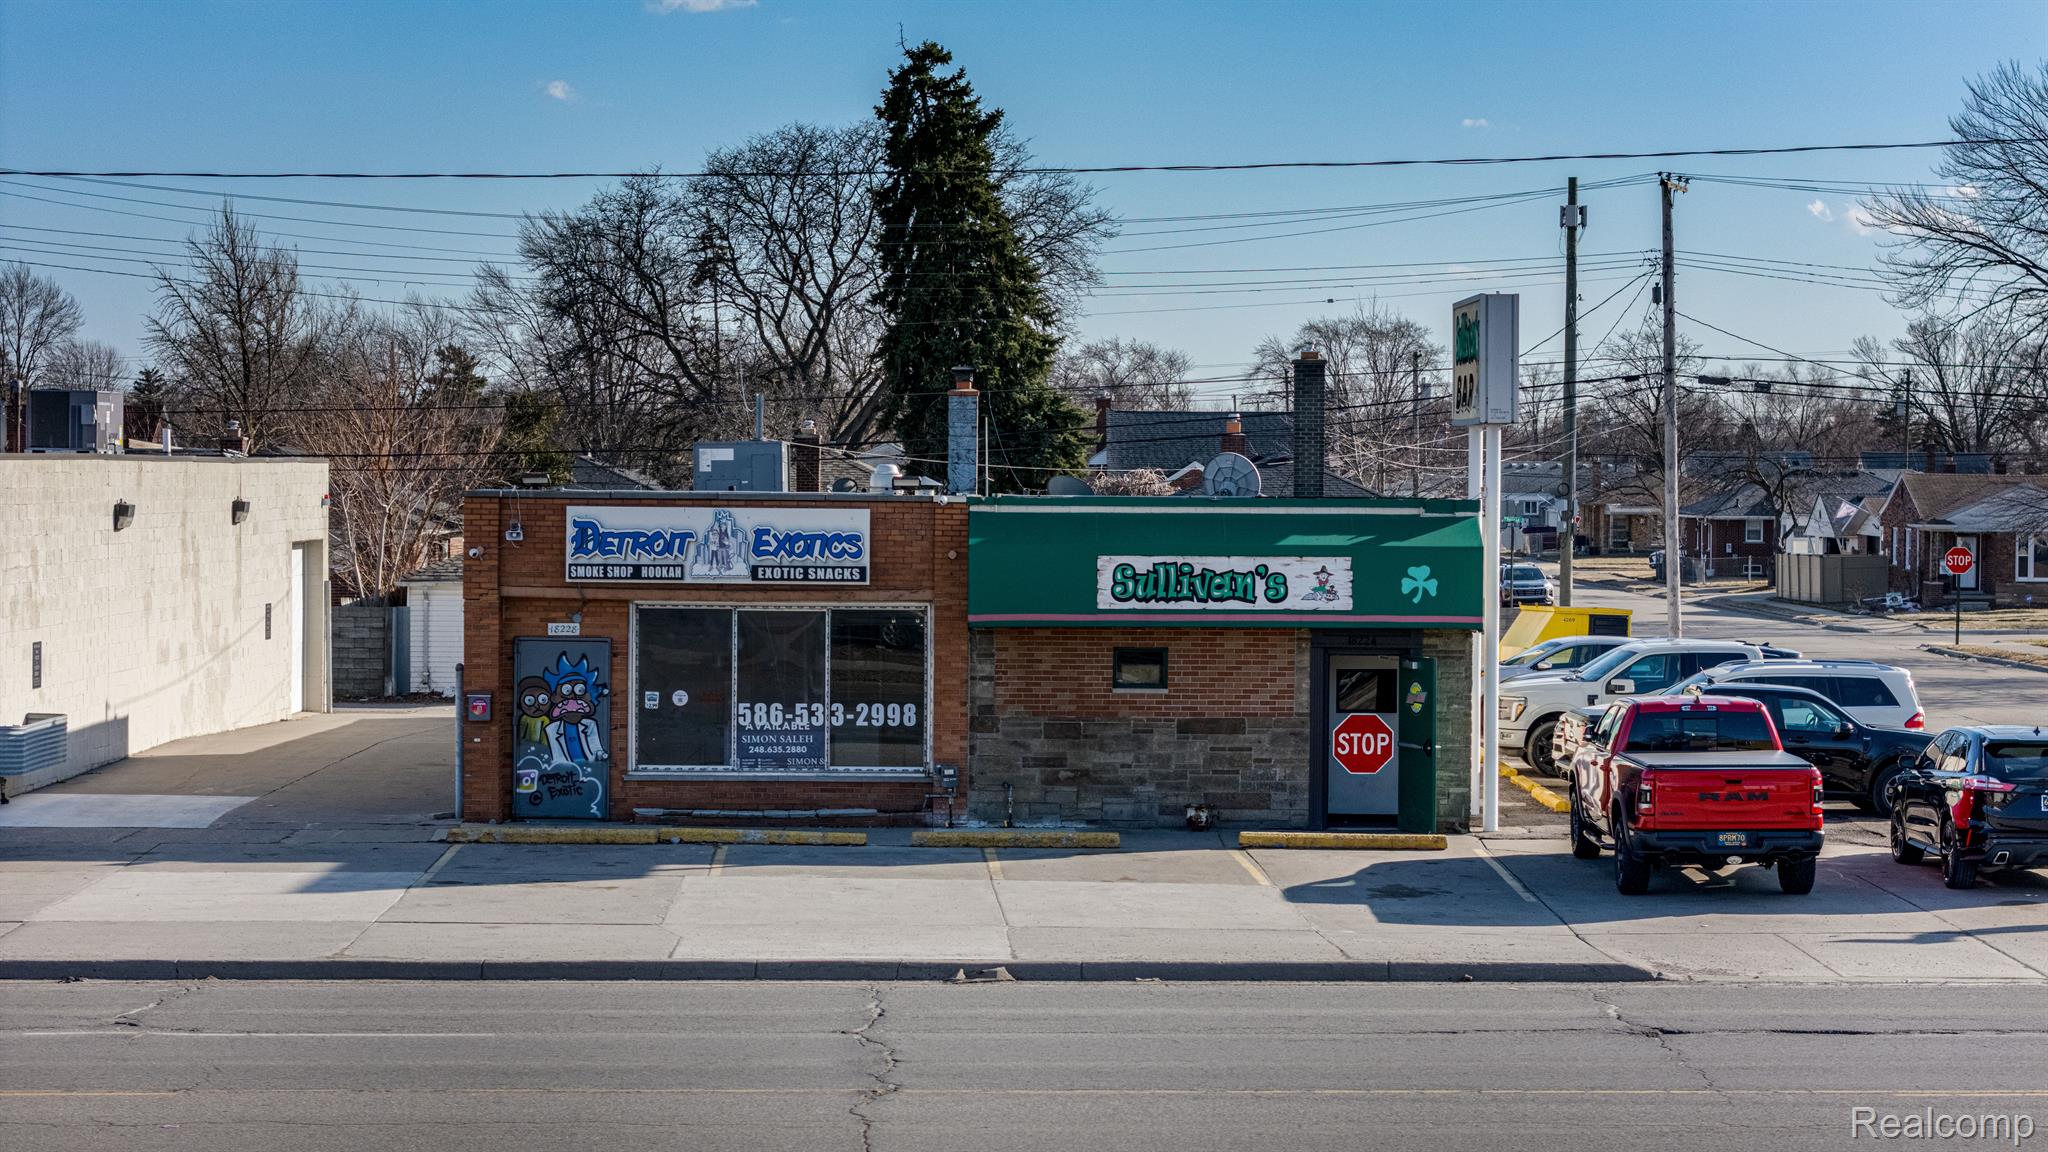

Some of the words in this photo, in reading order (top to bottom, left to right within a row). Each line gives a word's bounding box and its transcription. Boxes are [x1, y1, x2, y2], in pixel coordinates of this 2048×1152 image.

[570, 518, 696, 559] DETROIT
[751, 527, 864, 560] EXOTICS
[1947, 555, 1971, 566] STOP
[570, 565, 604, 578] SMOKE
[607, 565, 633, 578] SHOP
[641, 566, 682, 578] HOOKAH
[757, 567, 804, 579] EXOTIC
[808, 567, 860, 580] SNACKS
[1111, 562, 1288, 604] Sullivan's
[549, 624, 577, 634] 18228
[738, 702, 916, 727] 586-533-2998
[741, 735, 777, 744] SIMON
[779, 735, 813, 743] SALEH
[1337, 732, 1390, 755] STOP
[748, 745, 808, 754] 248.635.2880
[787, 757, 817, 766] SIMON
[1699, 791, 1769, 801] RAM
